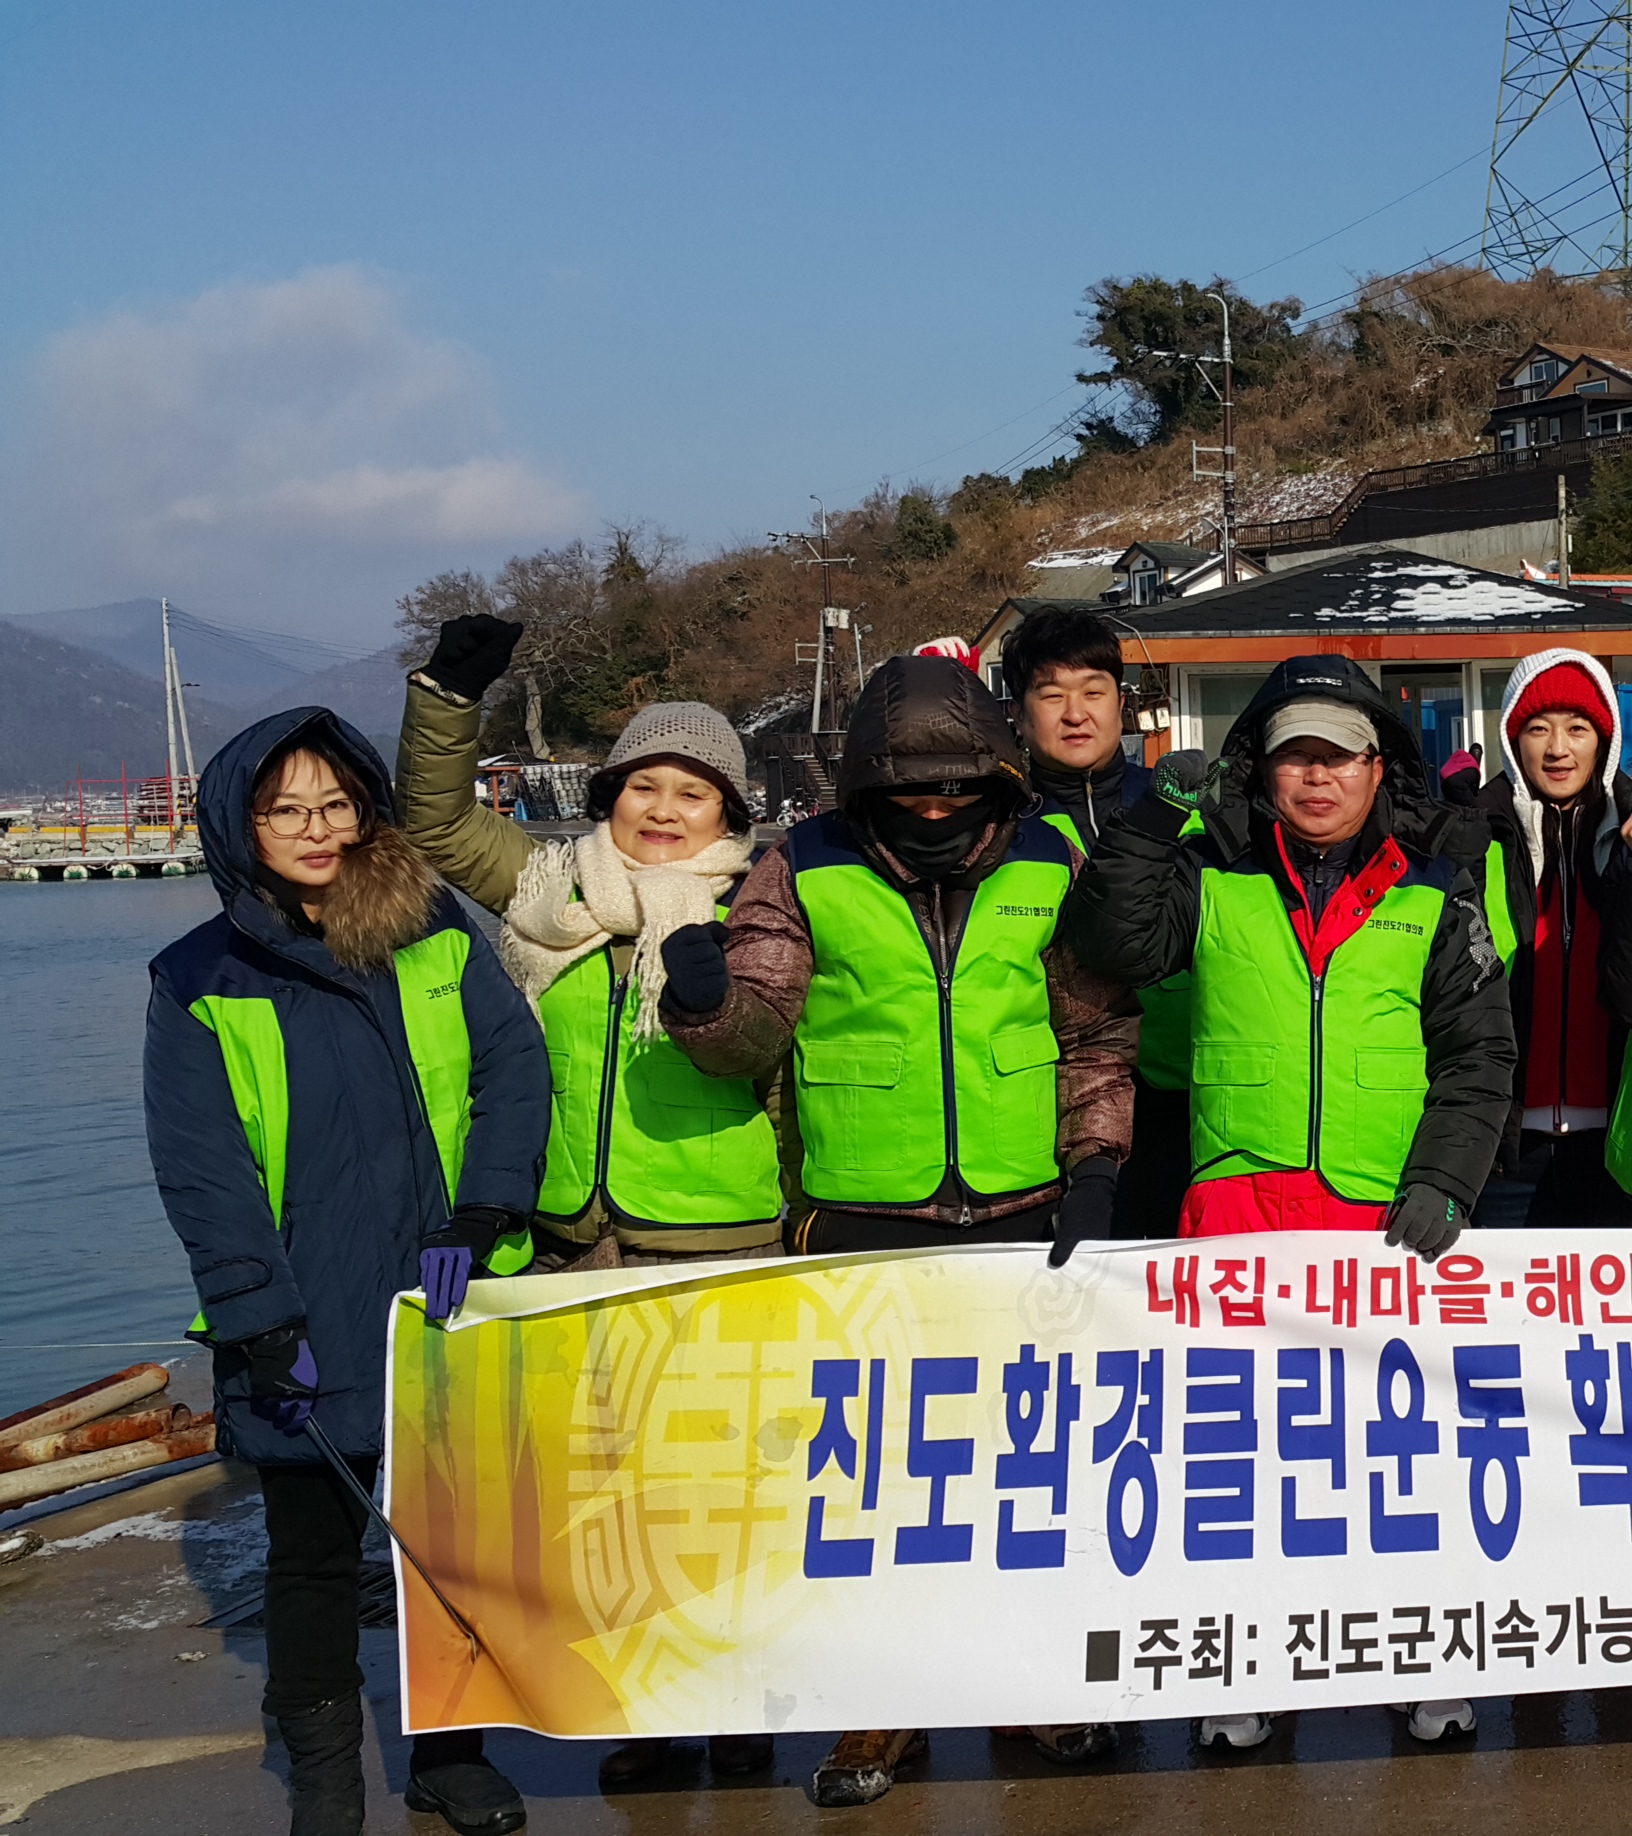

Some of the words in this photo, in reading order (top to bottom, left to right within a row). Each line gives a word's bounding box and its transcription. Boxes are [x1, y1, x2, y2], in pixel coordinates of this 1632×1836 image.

[996, 905, 1055, 918] 그린진도21협의회
[1367, 919, 1424, 936] 그린진도21협의회
[803, 1337, 1530, 1580] 진도환경클린운동
[1134, 1614, 1257, 1691] 주최:
